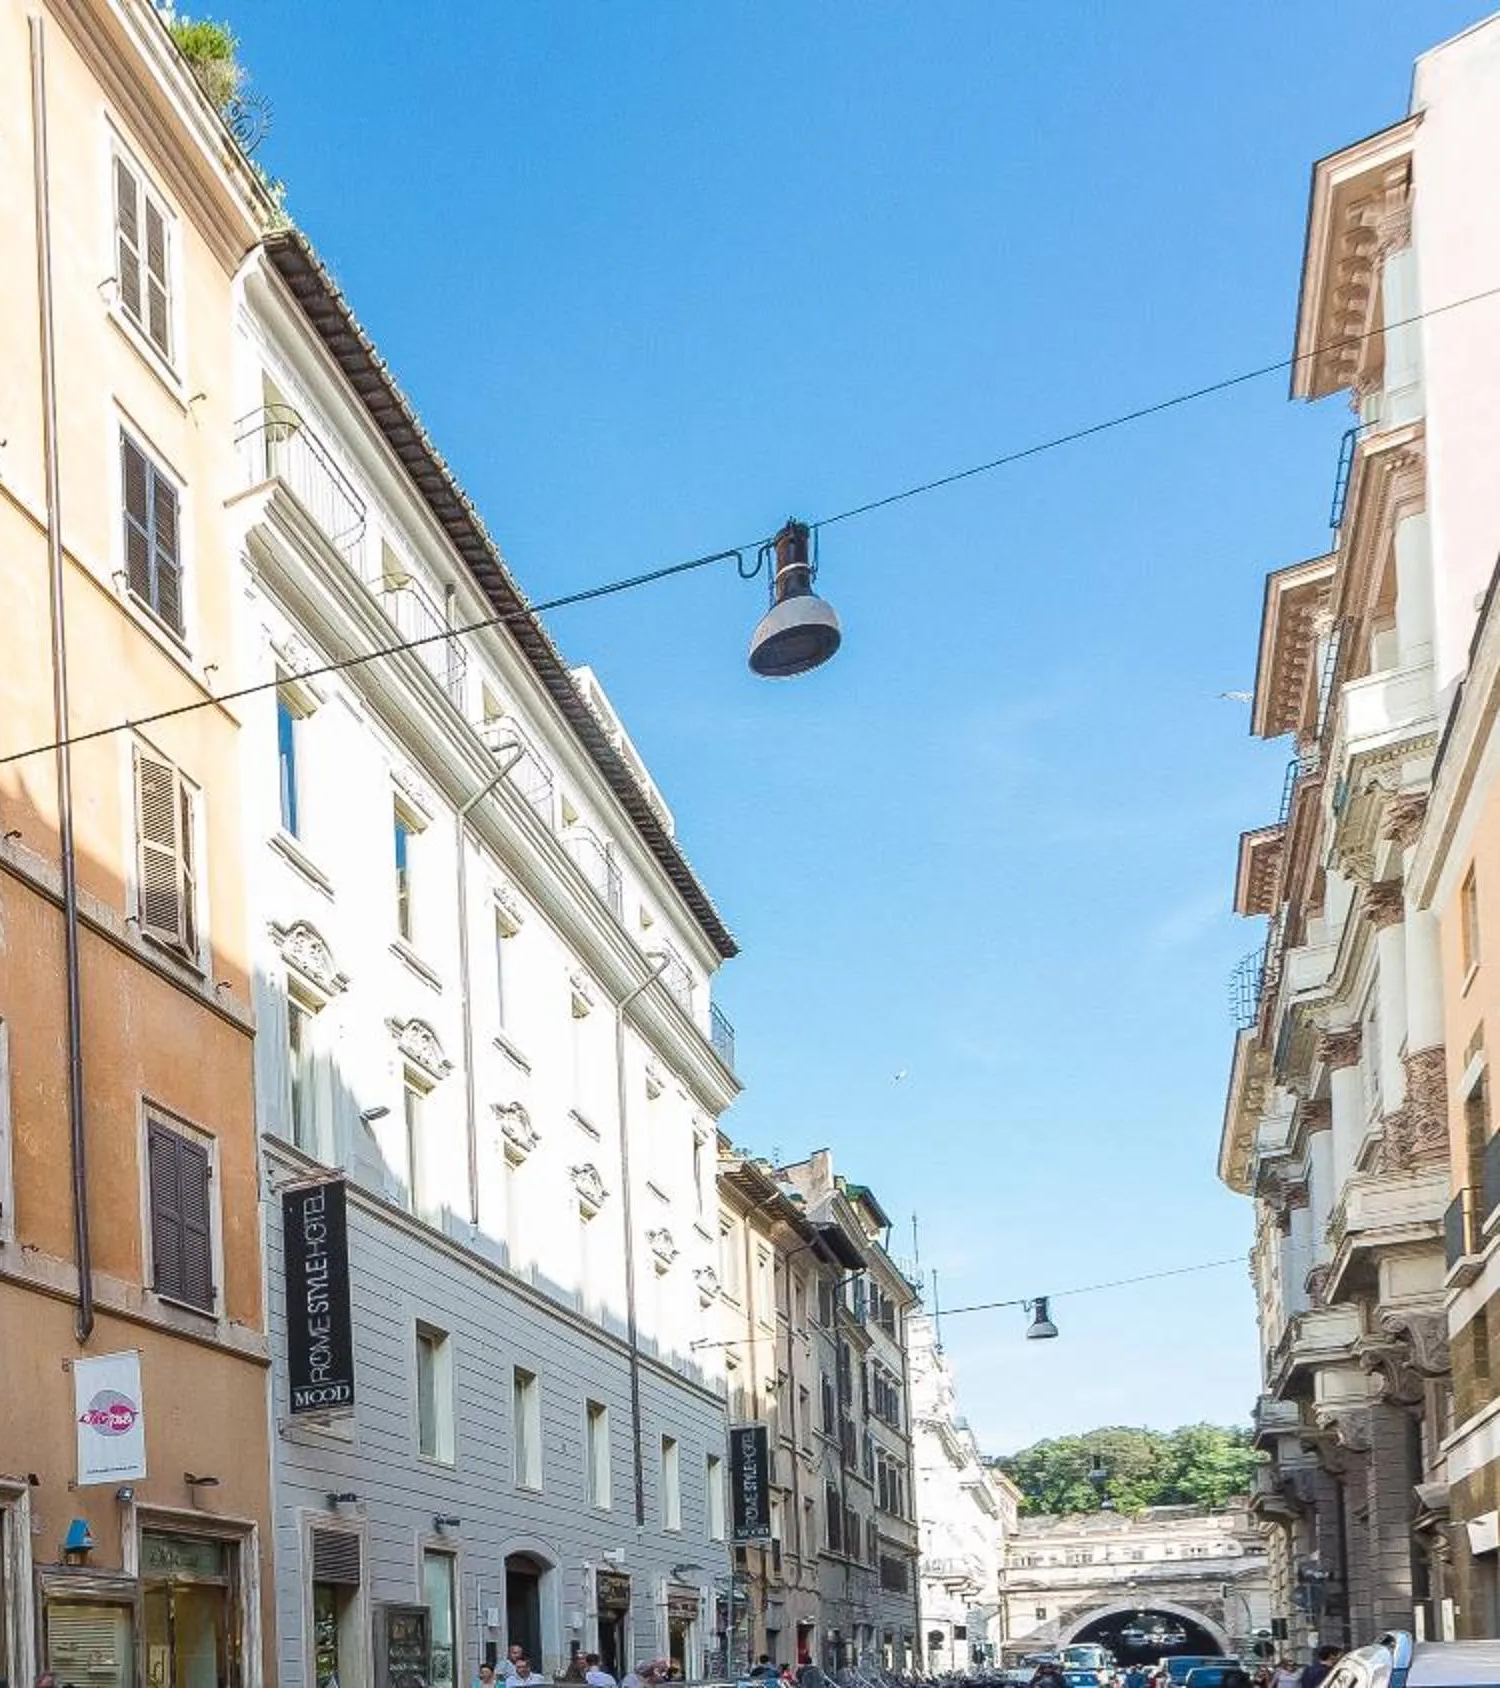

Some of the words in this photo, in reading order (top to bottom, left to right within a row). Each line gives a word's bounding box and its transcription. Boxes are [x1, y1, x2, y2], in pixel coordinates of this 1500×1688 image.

[302, 1185, 327, 1257] HOTEL
[305, 1256, 330, 1314] STYLE
[294, 1384, 350, 1407] MOOD
